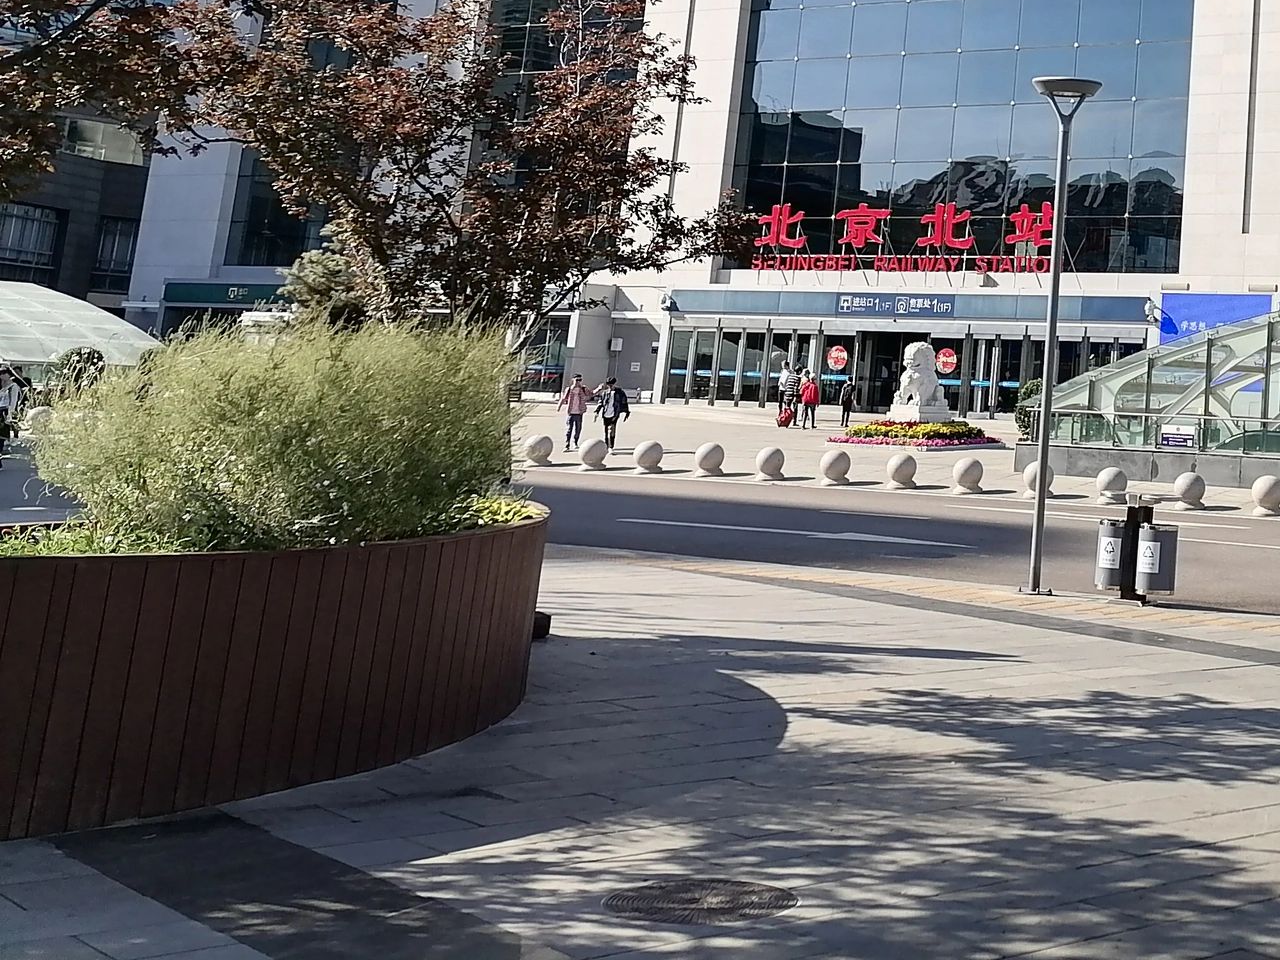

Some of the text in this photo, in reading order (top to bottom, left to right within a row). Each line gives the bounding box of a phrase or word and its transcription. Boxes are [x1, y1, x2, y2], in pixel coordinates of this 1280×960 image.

[754, 203, 1055, 250] 北京北站
[874, 256, 961, 272] RAILWAY
[974, 256, 1064, 274] STATIO
